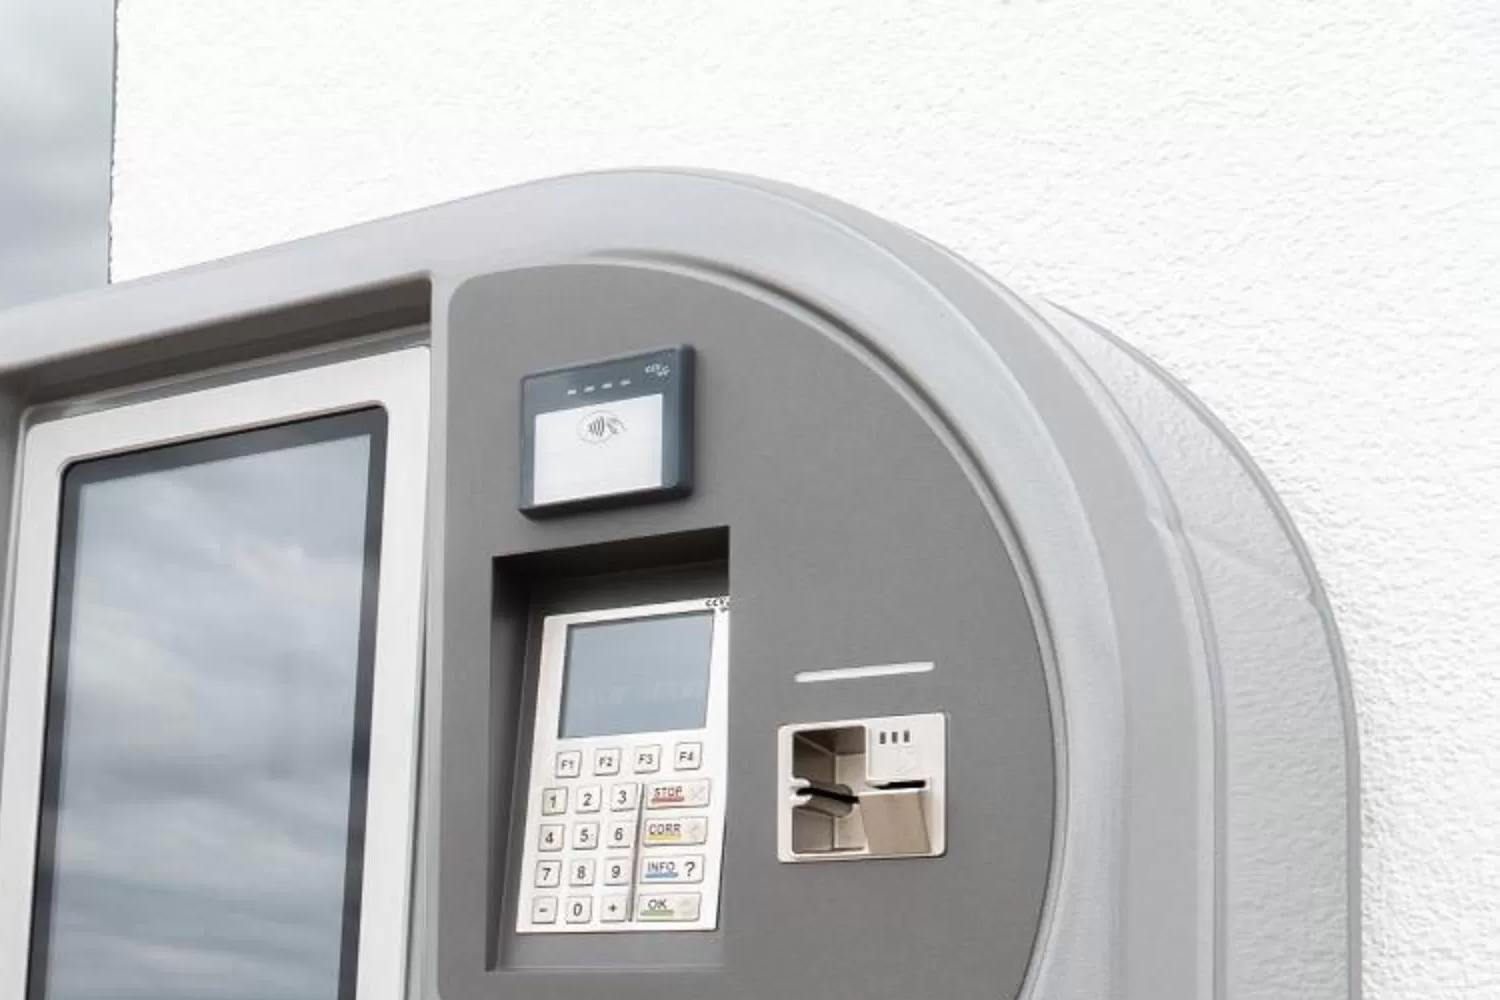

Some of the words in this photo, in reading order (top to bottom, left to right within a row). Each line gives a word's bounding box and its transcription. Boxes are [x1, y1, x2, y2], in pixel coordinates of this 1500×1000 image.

[599, 756, 612, 767] F2
[637, 753, 653, 765] F3
[679, 750, 693, 762] F4
[561, 759, 574, 770] F1
[618, 790, 627, 804] 3
[653, 786, 683, 798] STOP
[550, 796, 557, 808] 1
[583, 793, 593, 806] 2
[579, 829, 589, 842] 5
[614, 828, 623, 841] 6
[649, 823, 681, 836] CORR
[544, 832, 554, 844] 4
[541, 868, 552, 881] 7
[577, 866, 586, 879] 8
[611, 865, 621, 879] 9
[648, 861, 675, 873] INFO
[684, 861, 696, 877] ?
[573, 903, 582, 917] 0
[648, 899, 668, 910] OK
